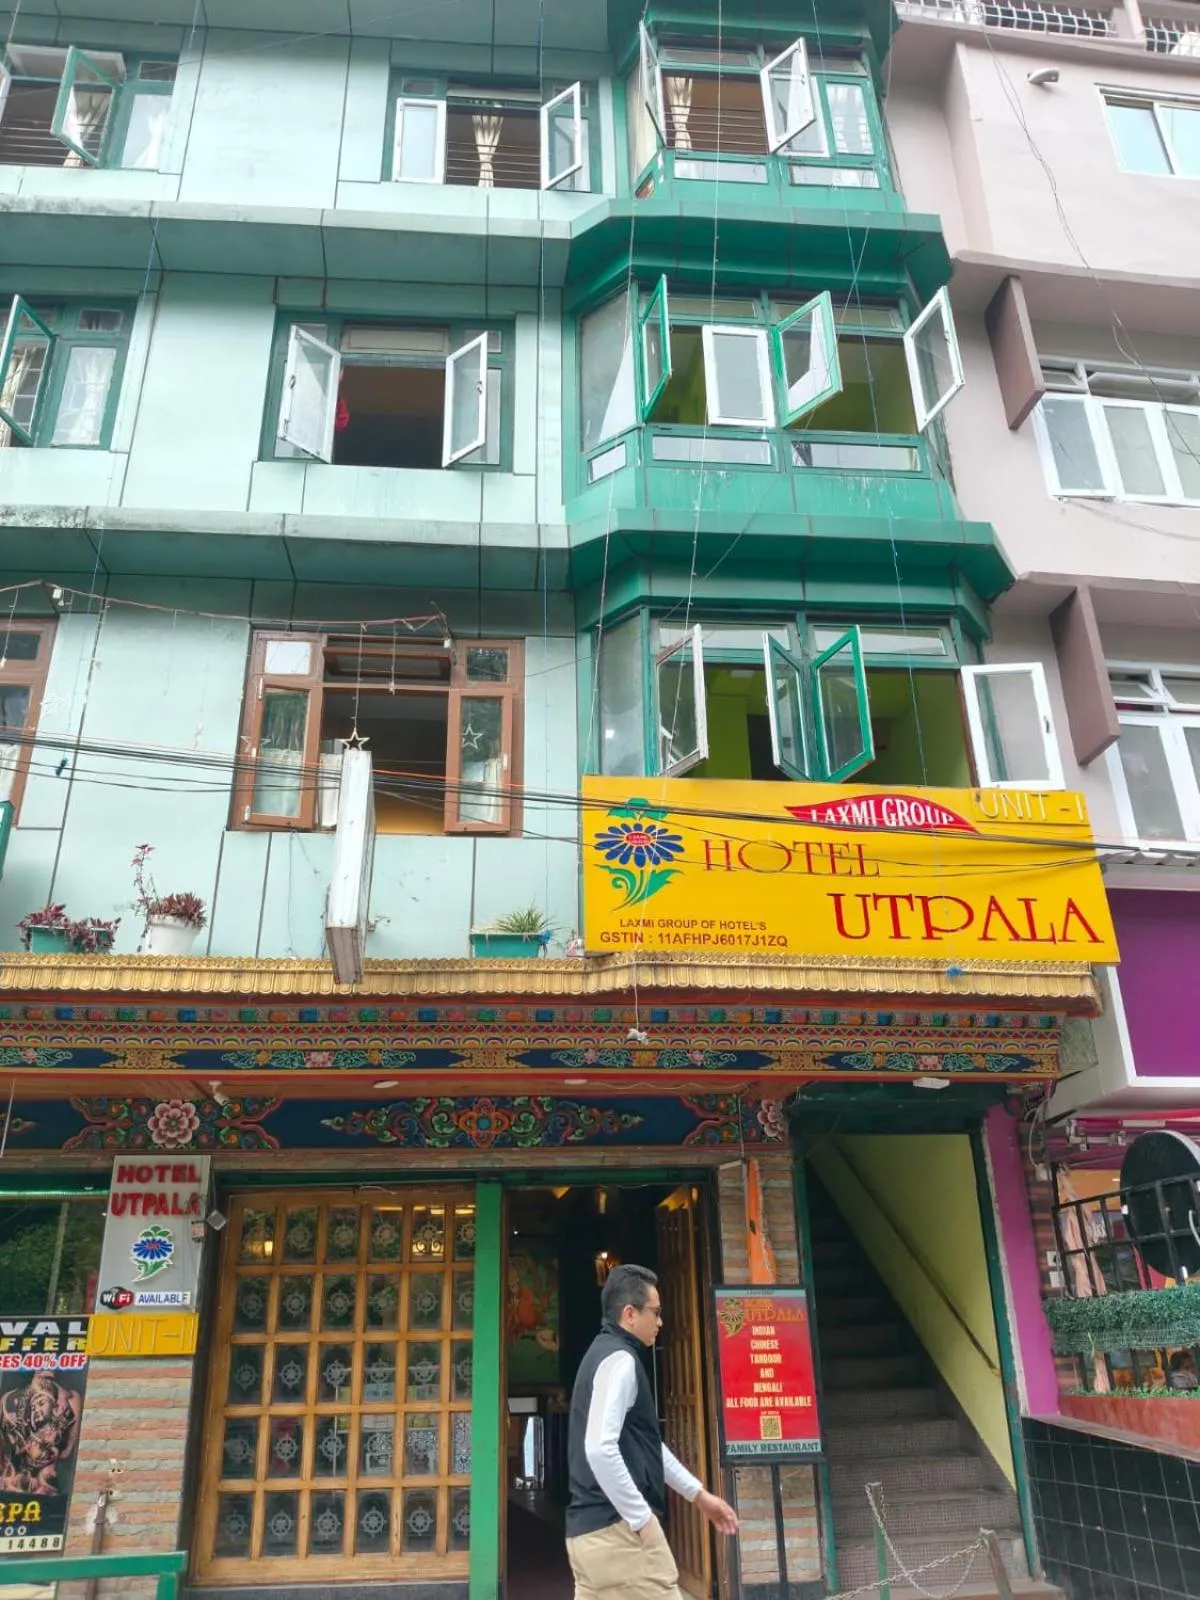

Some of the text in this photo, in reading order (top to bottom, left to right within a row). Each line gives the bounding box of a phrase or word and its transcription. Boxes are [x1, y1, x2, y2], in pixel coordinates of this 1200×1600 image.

[978, 790, 1049, 820] UNIT
[810, 798, 955, 827] LAXMI GROUP
[701, 838, 880, 878] HOTEL
[620, 918, 768, 931] LAXMI GROUP OF HOTEL'S
[826, 892, 1104, 945] UTPALA
[600, 931, 644, 944] GSTIN
[116, 1164, 202, 1184] HOTEL
[111, 1192, 201, 1217] UTPALA
[750, 1339, 779, 1350] CHINESE
[0, 1353, 87, 1369] ES 40% OFF
[750, 1353, 782, 1365] TANDOOR
[760, 1367, 775, 1379] AND
[754, 1382, 783, 1393] BENGALI
[726, 1395, 813, 1409] ALL FOOD ARE AVAILABLE
[759, 1441, 819, 1453] RESTAURANT
